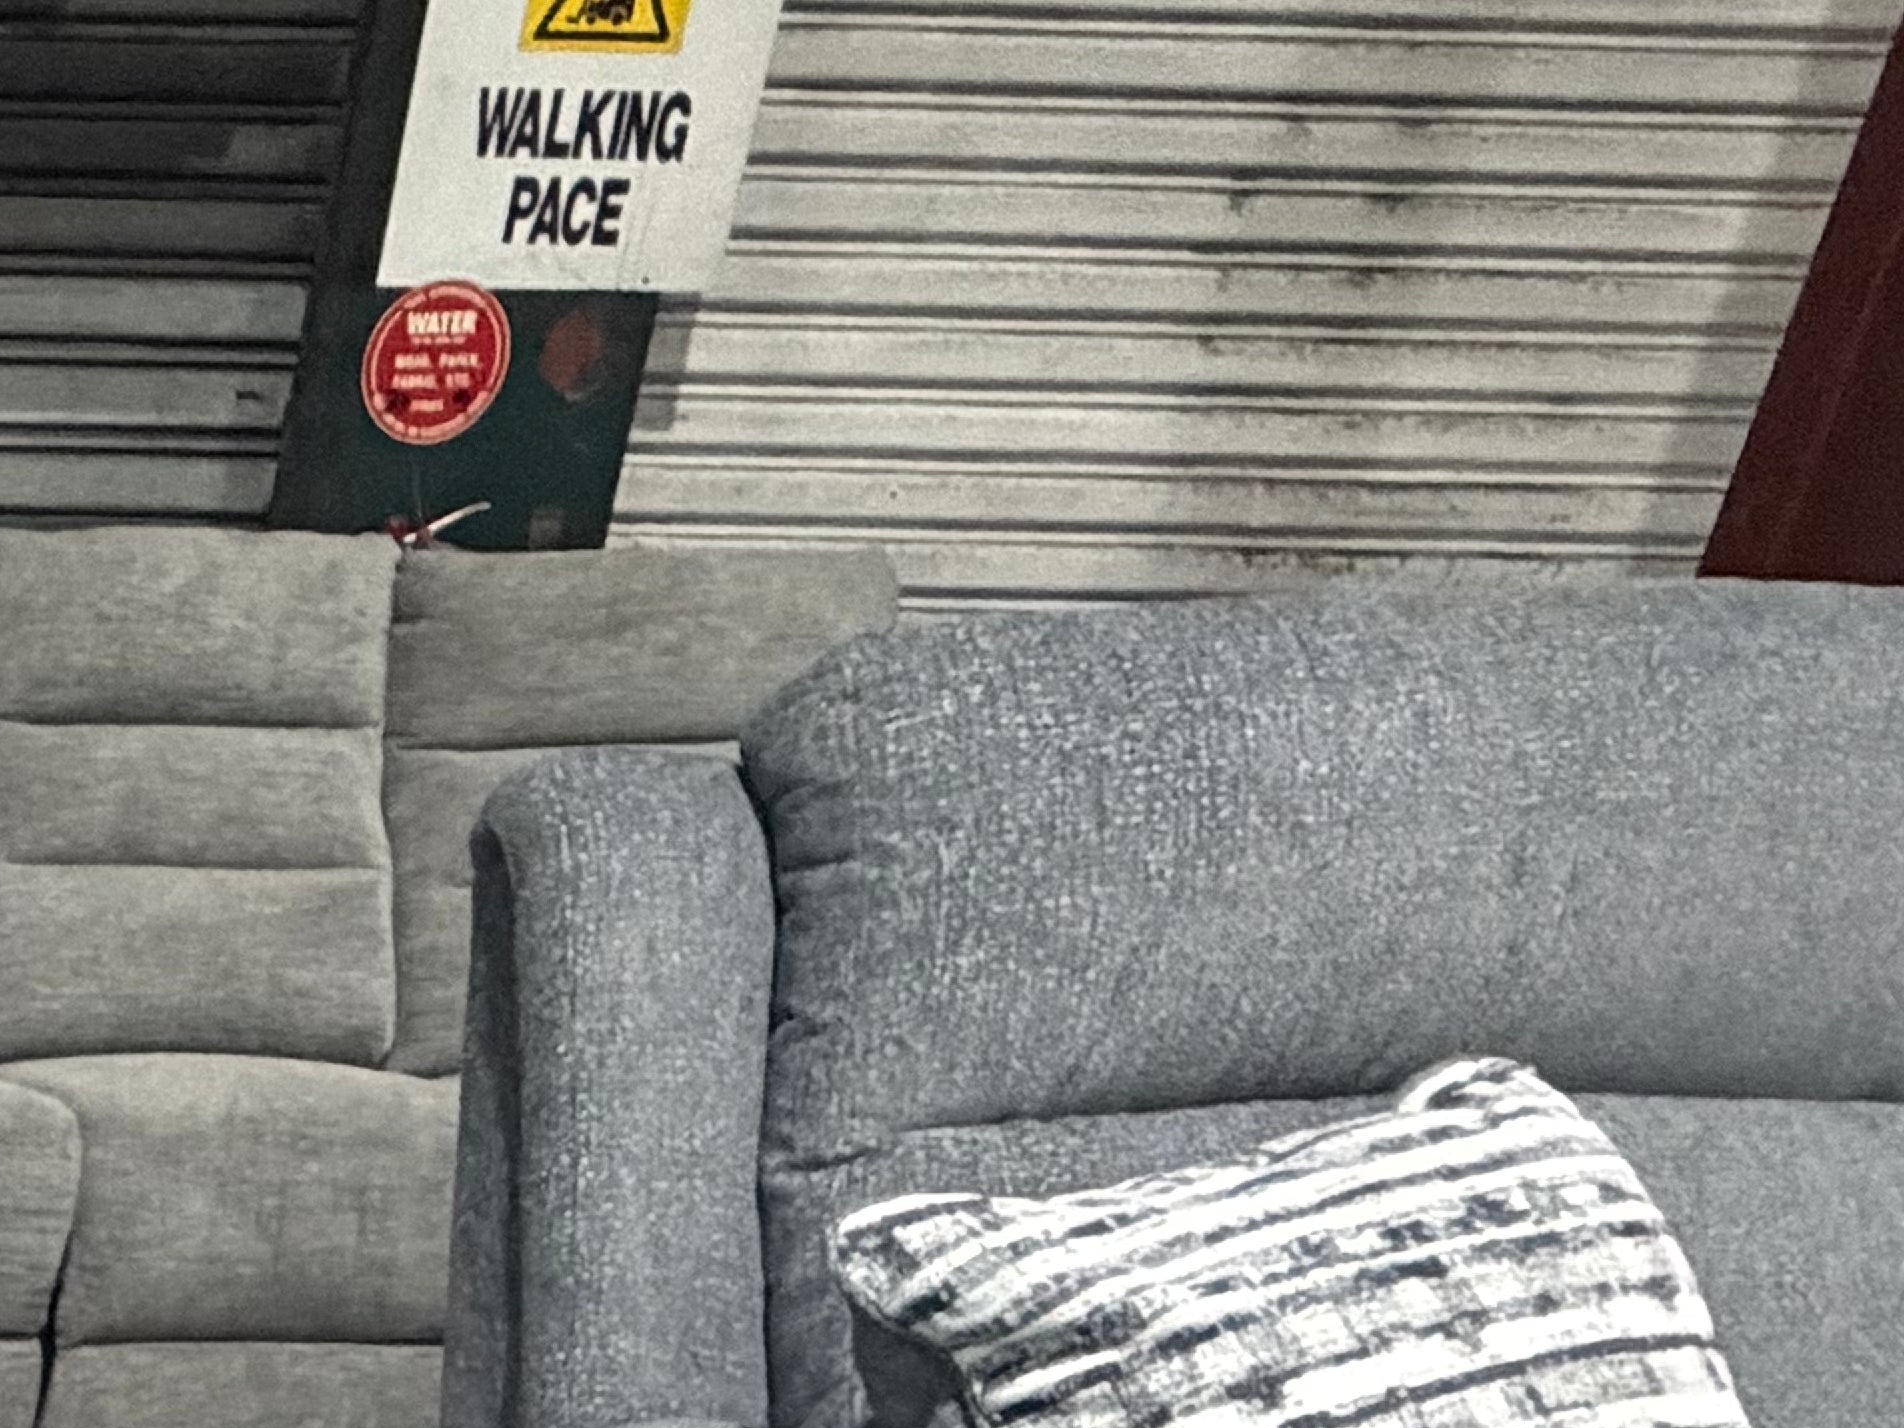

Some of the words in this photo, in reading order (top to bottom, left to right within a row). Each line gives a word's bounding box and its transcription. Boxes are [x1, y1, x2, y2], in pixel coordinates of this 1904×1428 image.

[476, 86, 692, 162] WALKING
[502, 176, 630, 246] PACE
[406, 310, 478, 335] WATER
